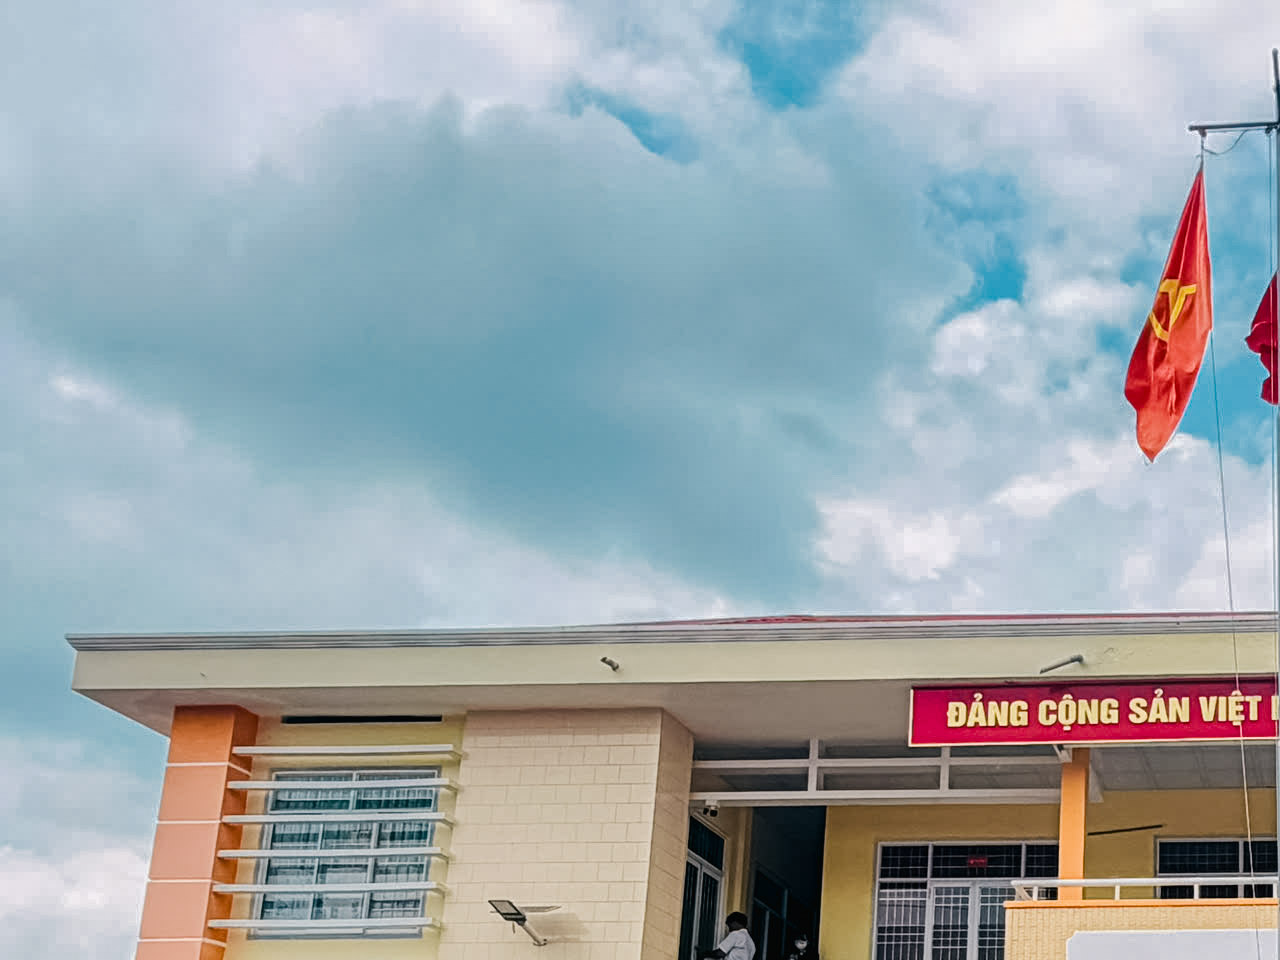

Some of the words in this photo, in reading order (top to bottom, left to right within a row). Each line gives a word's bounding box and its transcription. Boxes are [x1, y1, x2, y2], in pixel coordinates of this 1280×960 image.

[947, 692, 1029, 727] ĐẢNG
[1038, 694, 1120, 731] CỘNG
[1128, 688, 1190, 724] SẢN
[1198, 690, 1263, 726] VIỆT
